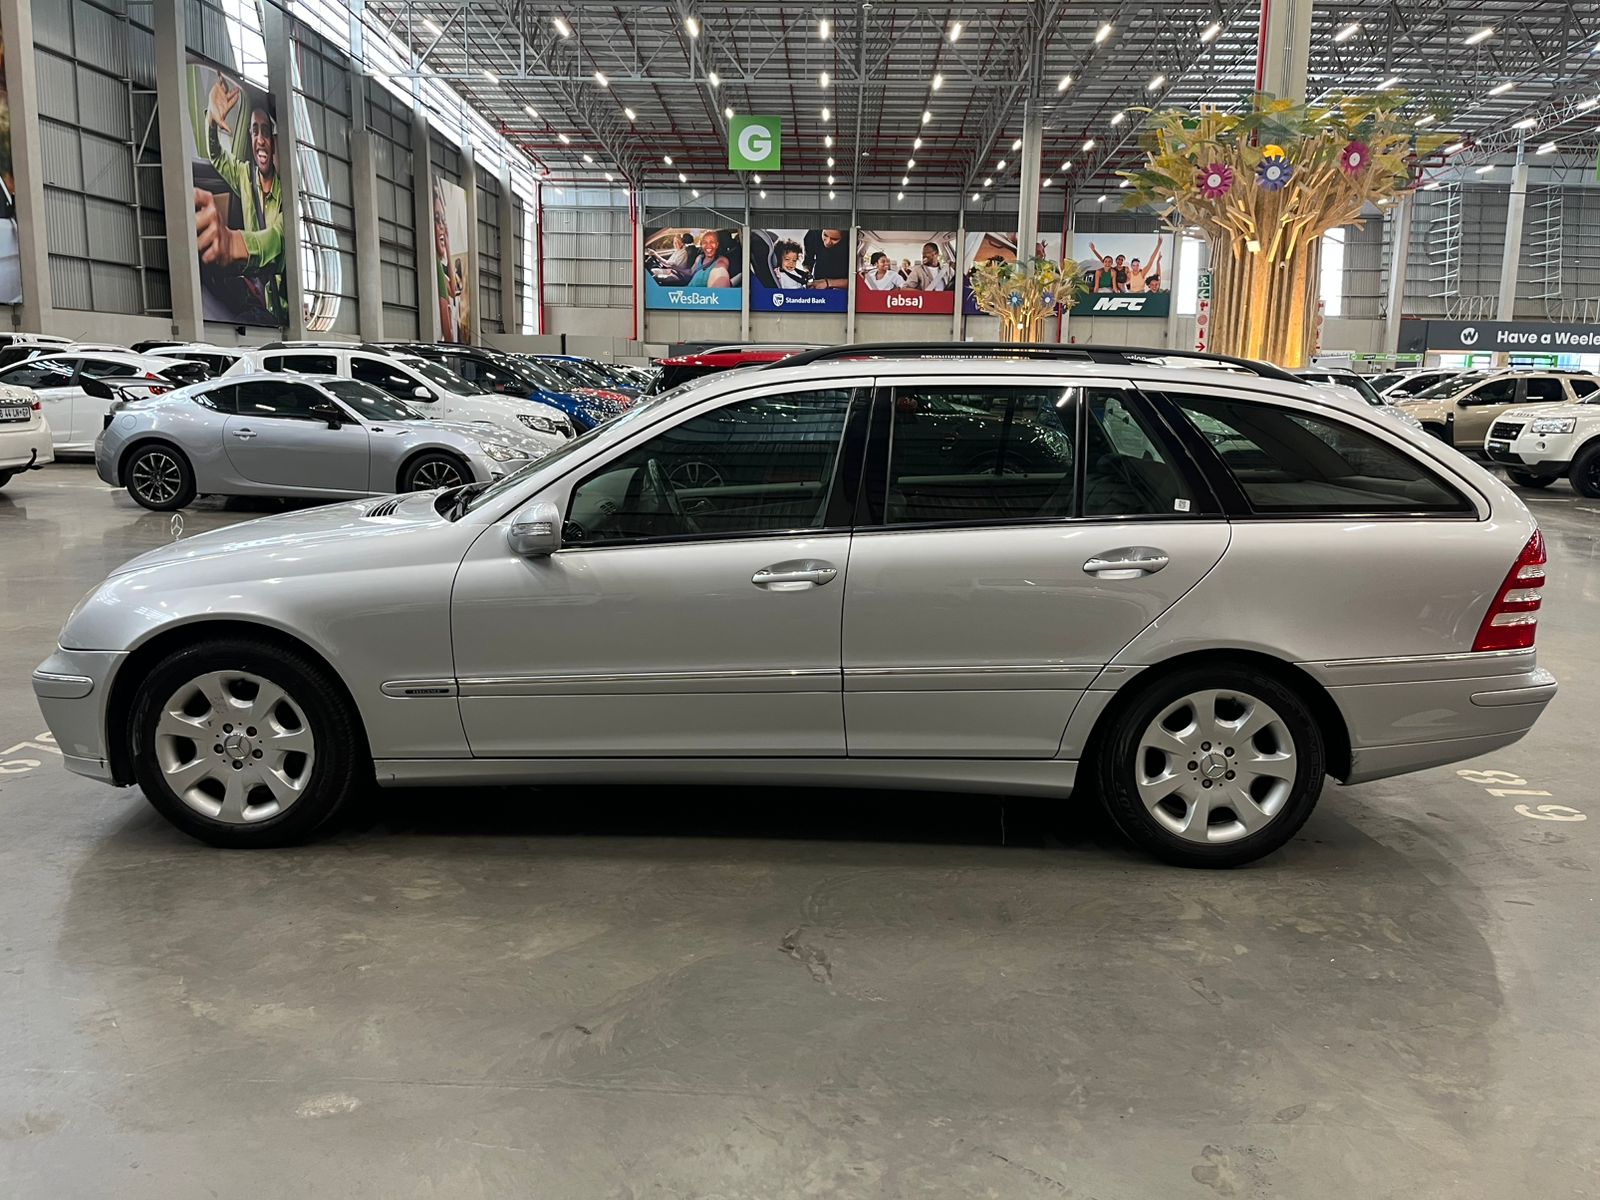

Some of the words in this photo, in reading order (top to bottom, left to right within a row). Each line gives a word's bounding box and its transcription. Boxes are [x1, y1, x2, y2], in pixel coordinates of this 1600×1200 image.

[738, 124, 772, 161] G
[668, 290, 719, 305] WesBank
[1093, 297, 1146, 311] MFC
[1497, 330, 1538, 344] Have
[1540, 333, 1551, 344] a
